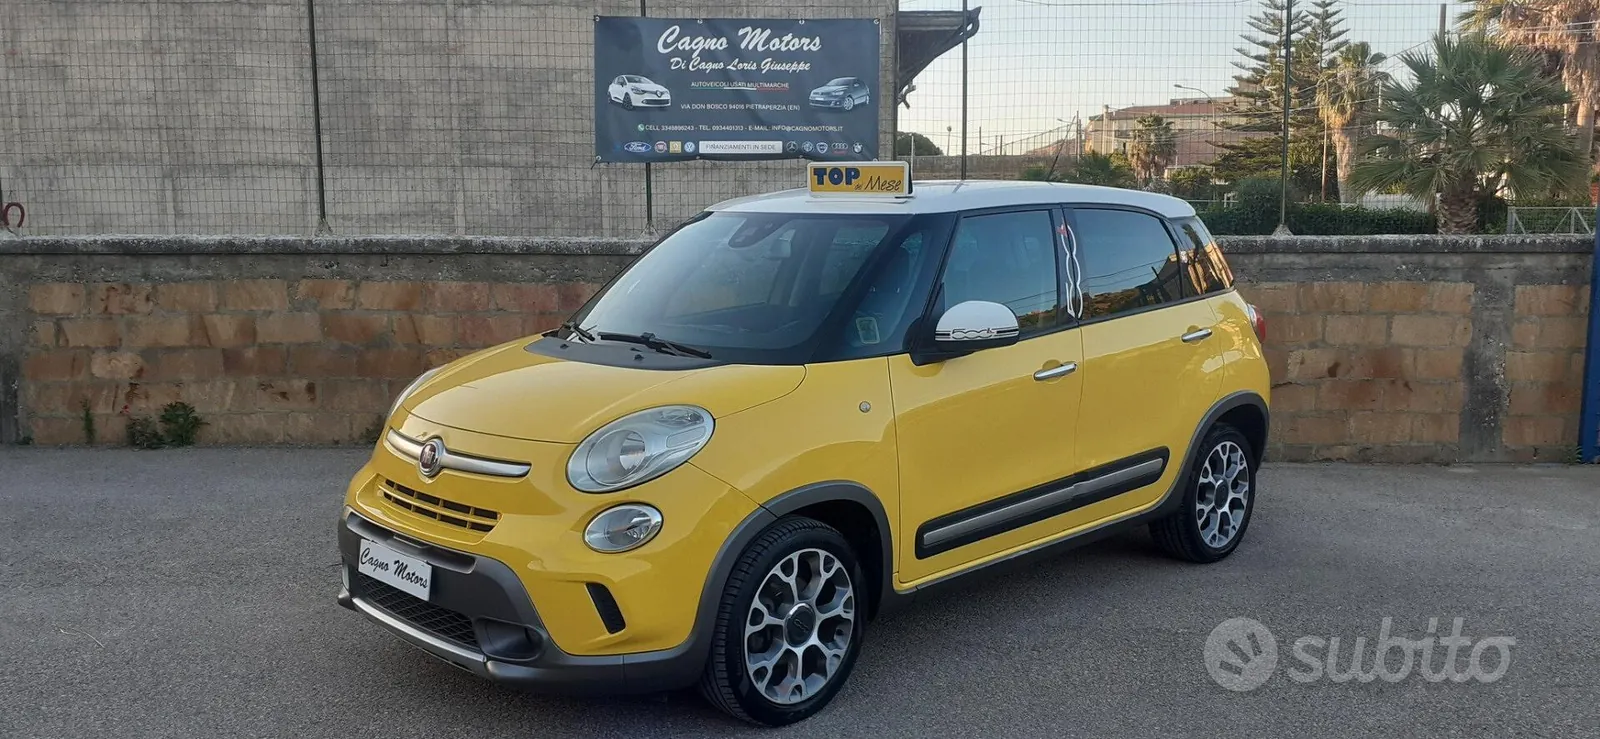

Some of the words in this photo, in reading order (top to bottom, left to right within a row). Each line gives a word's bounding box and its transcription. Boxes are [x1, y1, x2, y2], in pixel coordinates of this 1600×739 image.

[657, 25, 728, 58] Cagno
[738, 26, 822, 52] Motors
[670, 57, 686, 70] Di
[688, 56, 724, 73] Cagno
[727, 58, 757, 71] Loris
[760, 57, 811, 74] Giuseppe
[813, 167, 860, 186] TOP
[864, 175, 902, 191] Mese
[360, 547, 389, 572] Cagno
[394, 560, 428, 588] Motors
